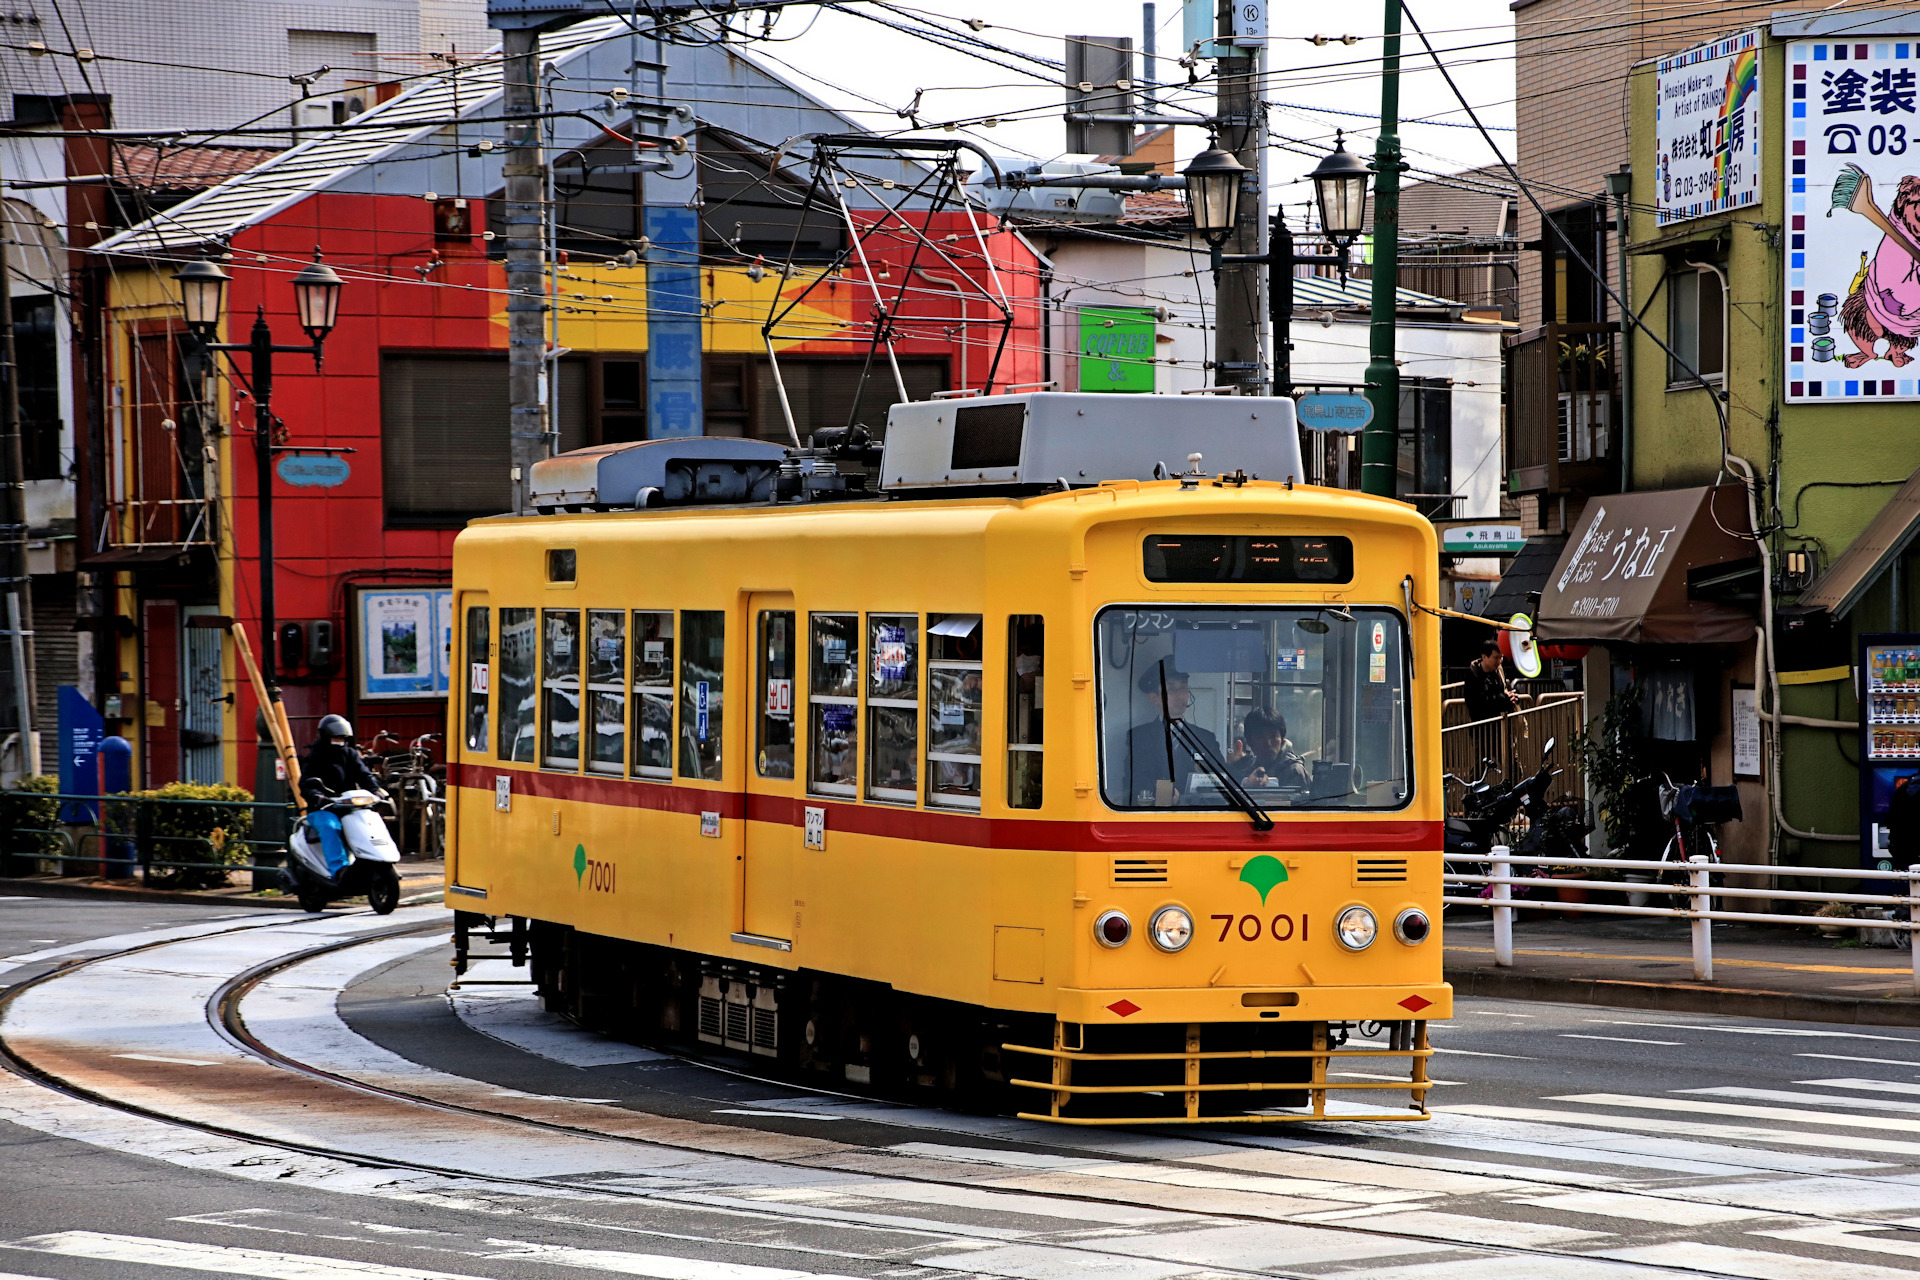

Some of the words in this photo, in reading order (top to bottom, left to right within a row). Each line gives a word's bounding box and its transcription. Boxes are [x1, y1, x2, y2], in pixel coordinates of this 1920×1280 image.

[1664, 80, 1686, 101] Housing
[1687, 74, 1713, 93] Make-up
[1820, 67, 1917, 115] 塗装
[1674, 99, 1688, 119] Artist
[1693, 97, 1700, 112] of
[1701, 87, 1727, 112] RAINBOW
[1671, 131, 1698, 162] 株式会社
[1699, 107, 1745, 160] 虹工房
[1683, 162, 1742, 197] 03-3949-1951
[1086, 333, 1149, 354] COFFEE
[1108, 361, 1127, 381] &
[1479, 531, 1516, 541] 飛鳥山
[1586, 529, 1614, 554] うなぎ
[1601, 525, 1677, 581] うな正
[1576, 597, 1620, 617] 3910-6700
[1125, 613, 1175, 629] ワンマン
[472, 666, 488, 690] 入口
[769, 682, 789, 710] 出口
[806, 811, 824, 826] ワンマン
[587, 859, 616, 894] 7001
[1210, 914, 1309, 943] 7001
